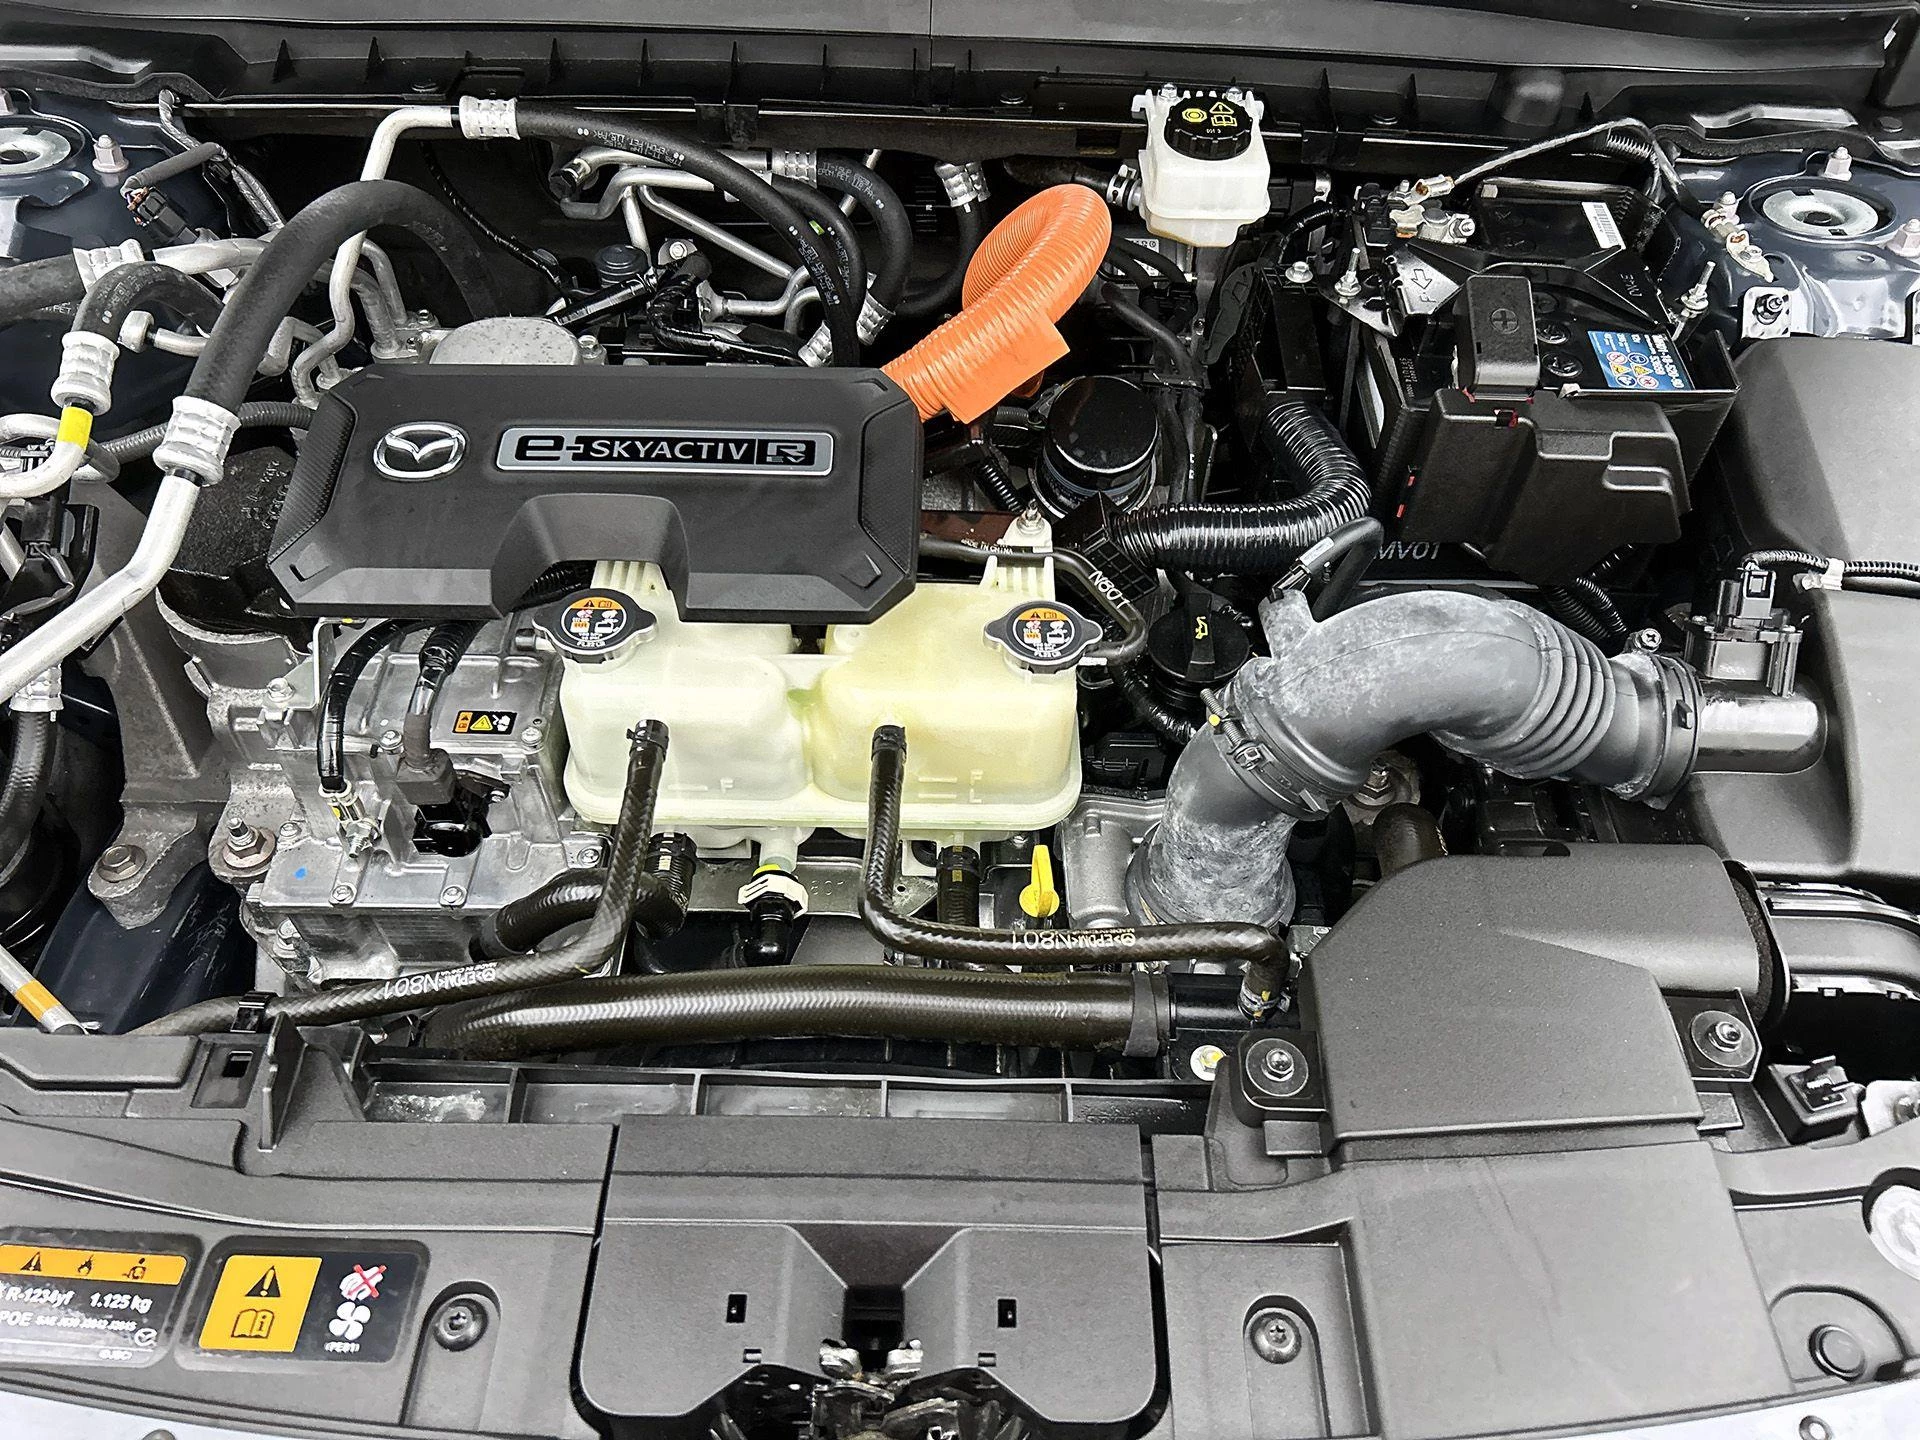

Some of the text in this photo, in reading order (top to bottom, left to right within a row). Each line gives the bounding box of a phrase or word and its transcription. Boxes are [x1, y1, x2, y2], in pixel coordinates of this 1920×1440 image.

[1088, 571, 1130, 609] N801
[384, 971, 441, 1000] N801
[6, 1286, 153, 1314] R-1234yf 1.125 kg
